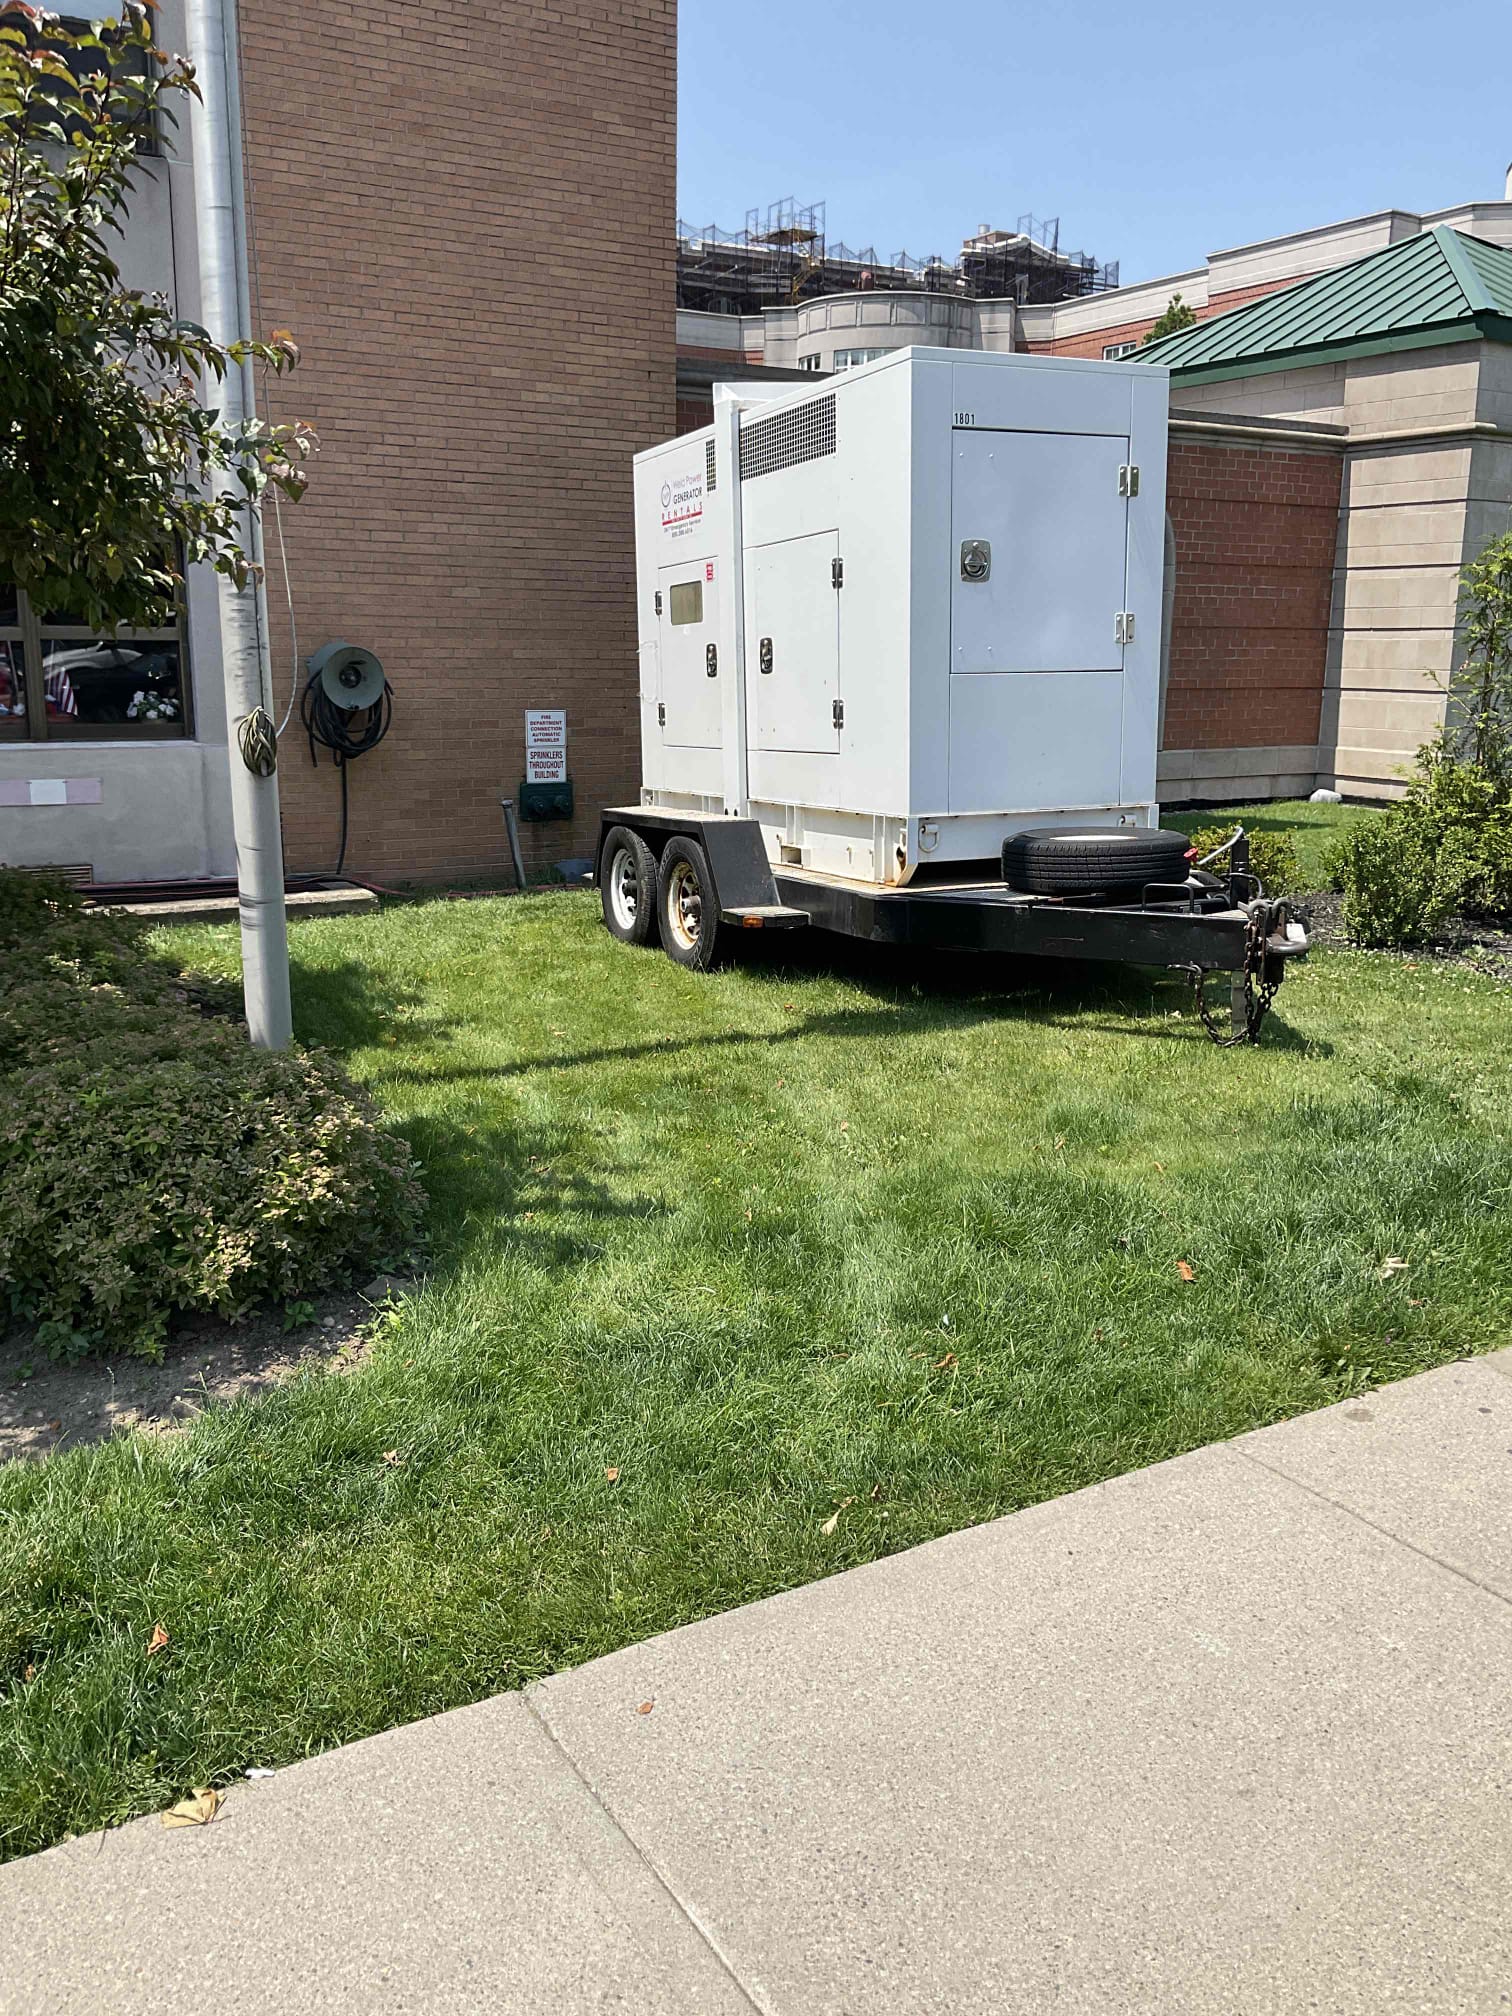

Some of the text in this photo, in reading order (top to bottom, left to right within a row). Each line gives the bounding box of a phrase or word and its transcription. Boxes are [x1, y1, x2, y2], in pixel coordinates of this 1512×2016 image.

[954, 412, 975, 425] 1801
[673, 486, 703, 504] GENERATOR
[661, 501, 703, 520] RENTALS
[530, 751, 563, 760] SPRINKLERS
[529, 761, 564, 769] THROUGHOUT
[534, 771, 559, 779] BUILDING
